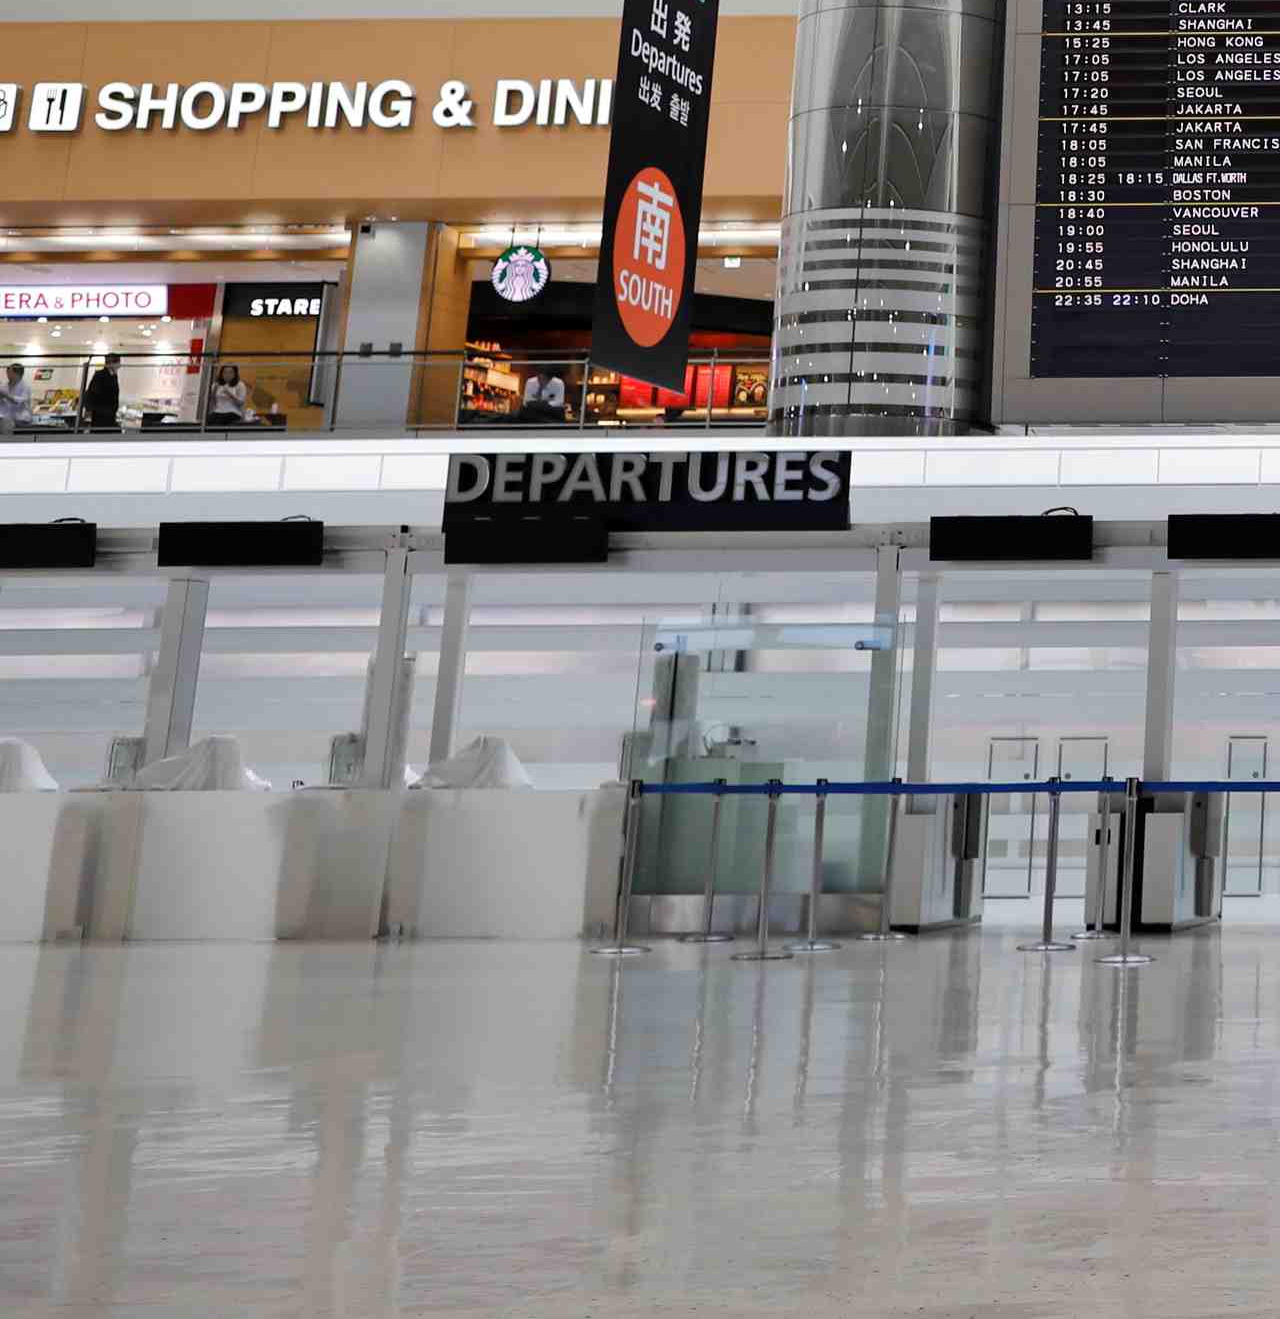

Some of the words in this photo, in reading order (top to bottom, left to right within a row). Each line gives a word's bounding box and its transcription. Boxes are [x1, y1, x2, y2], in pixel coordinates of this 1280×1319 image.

[1067, 3, 1111, 15] 13:15
[1178, 2, 1226, 14] CLARK
[1066, 19, 1111, 31] 13:45
[1178, 18, 1252, 30] SHANGHAI
[1065, 37, 1110, 49] 15:25
[1177, 36, 1216, 48] HONG
[1225, 36, 1264, 47] KONG
[630, 27, 703, 95] Departures
[1064, 54, 1110, 65] 17:05
[1177, 53, 1206, 65] LOS
[1064, 70, 1109, 82] 17:05
[1176, 70, 1205, 81] LOS
[638, 75, 663, 112] 出发
[1063, 87, 1109, 99] 17:20
[1176, 86, 1223, 98] SEOUL
[95, 79, 416, 130] SHOPPING
[431, 79, 474, 128] &
[493, 78, 613, 126] DINI
[1063, 104, 1108, 116] 17:45
[1176, 103, 1242, 115] JAKARTA
[1062, 122, 1107, 134] 17:45
[1176, 121, 1243, 133] JAKARTA
[1062, 139, 1107, 151] 18:05
[1175, 139, 1203, 150] SAN
[1061, 156, 1106, 168] 18:05
[1174, 155, 1232, 167] MANILA
[1060, 173, 1106, 185] 18:25
[1118, 172, 1164, 185] 18:15
[1060, 190, 1105, 202] 18:30
[1173, 189, 1231, 201] BOSTON
[1059, 208, 1105, 219] 18:40
[1172, 206, 1259, 218] VANCOUVER
[633, 181, 674, 270] 南
[1059, 225, 1104, 236] 19:00
[1172, 224, 1220, 236] SEOUL
[1058, 242, 1104, 254] 19:55
[1171, 241, 1249, 253] HONOLULU
[1056, 259, 1103, 271] 20:45
[1171, 258, 1247, 270] SHANGHAI
[1055, 276, 1103, 288] 20:55
[1170, 275, 1229, 287] MANILA
[4, 293, 48, 310] ERA
[54, 296, 64, 310] &
[71, 291, 152, 309] PHOTO
[618, 268, 673, 320] SOUTH
[1055, 294, 1102, 306] 22:35
[1112, 294, 1160, 306] 22:10
[1170, 293, 1209, 305] DOHA
[446, 451, 841, 503] DEPARTURES
